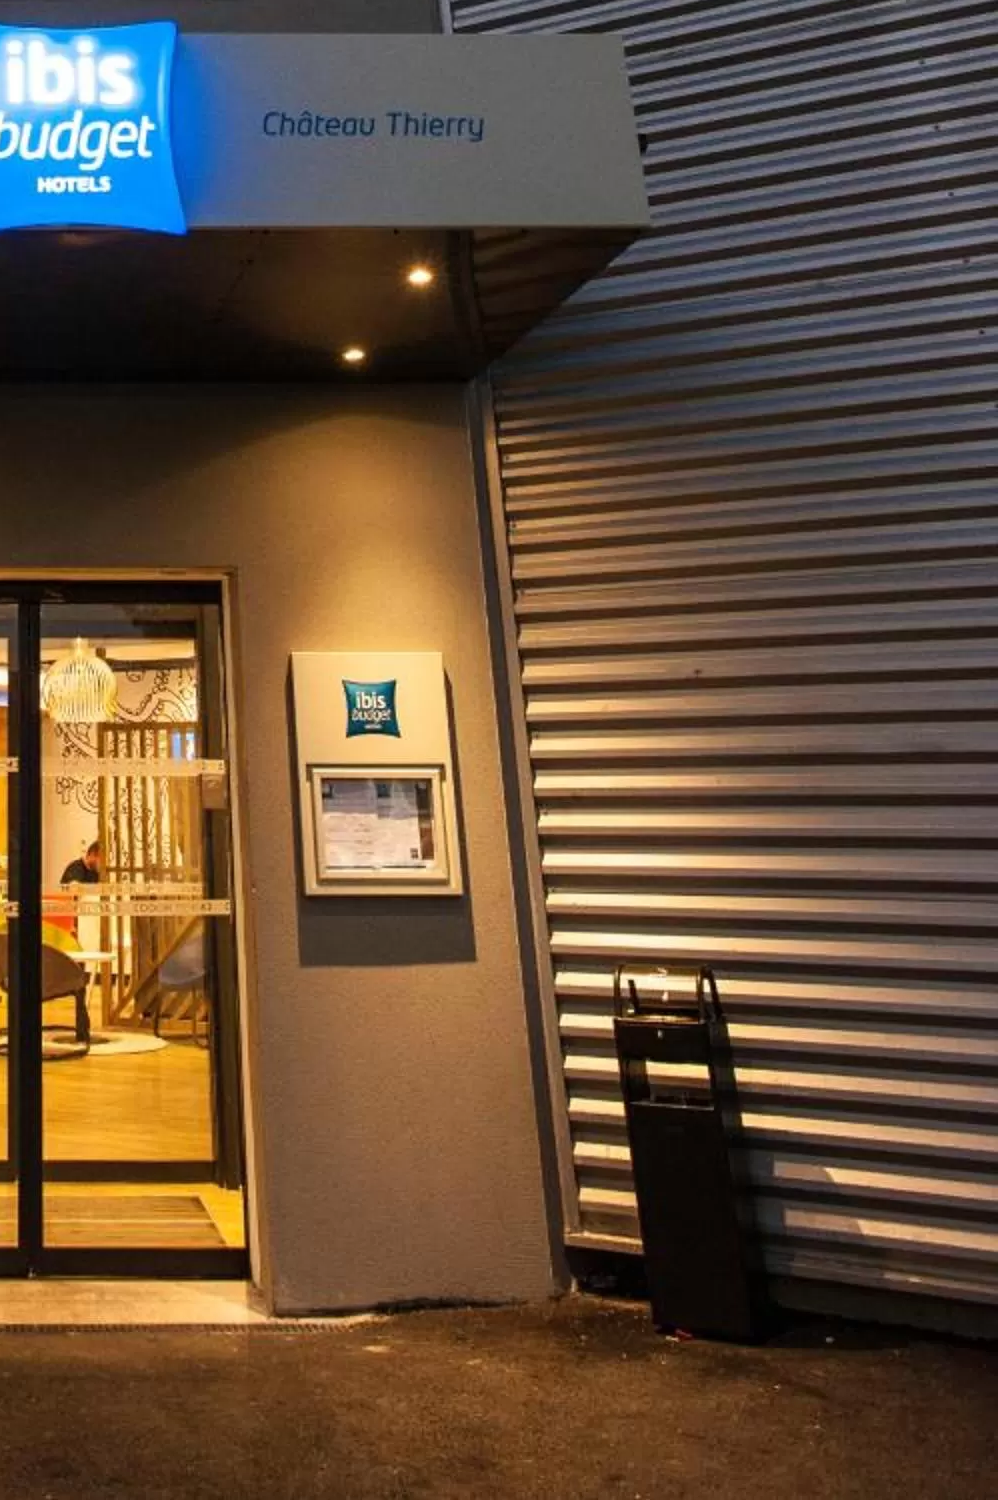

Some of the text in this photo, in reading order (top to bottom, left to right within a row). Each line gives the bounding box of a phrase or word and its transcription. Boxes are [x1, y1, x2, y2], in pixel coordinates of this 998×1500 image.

[6, 39, 135, 105] ibis
[263, 110, 485, 143] Château Thierry
[36, 176, 112, 193] HOTELS
[355, 691, 387, 709] ibis
